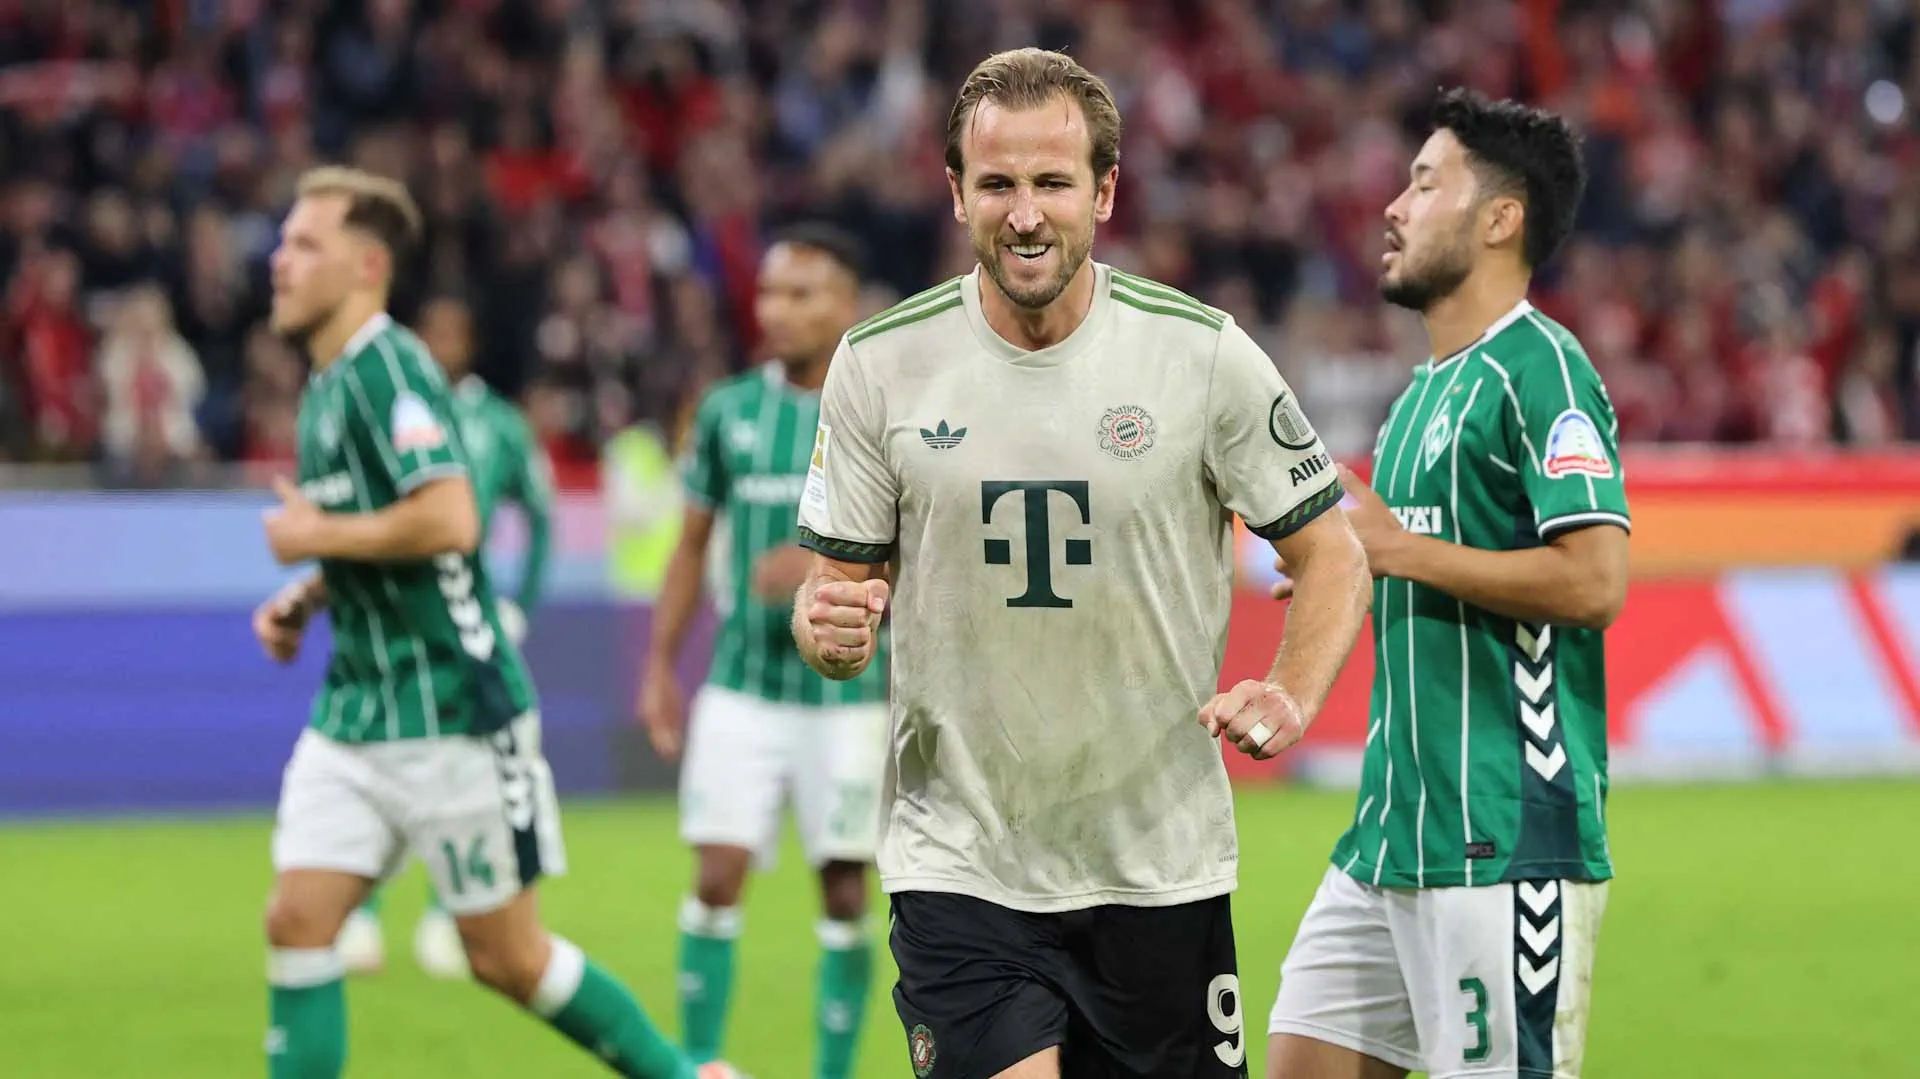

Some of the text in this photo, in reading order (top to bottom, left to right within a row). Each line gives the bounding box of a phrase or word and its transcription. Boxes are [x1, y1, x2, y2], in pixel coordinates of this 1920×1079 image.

[982, 480, 1091, 608] T
[1207, 973, 1245, 1068] 9
[1458, 977, 1491, 1062] 3
